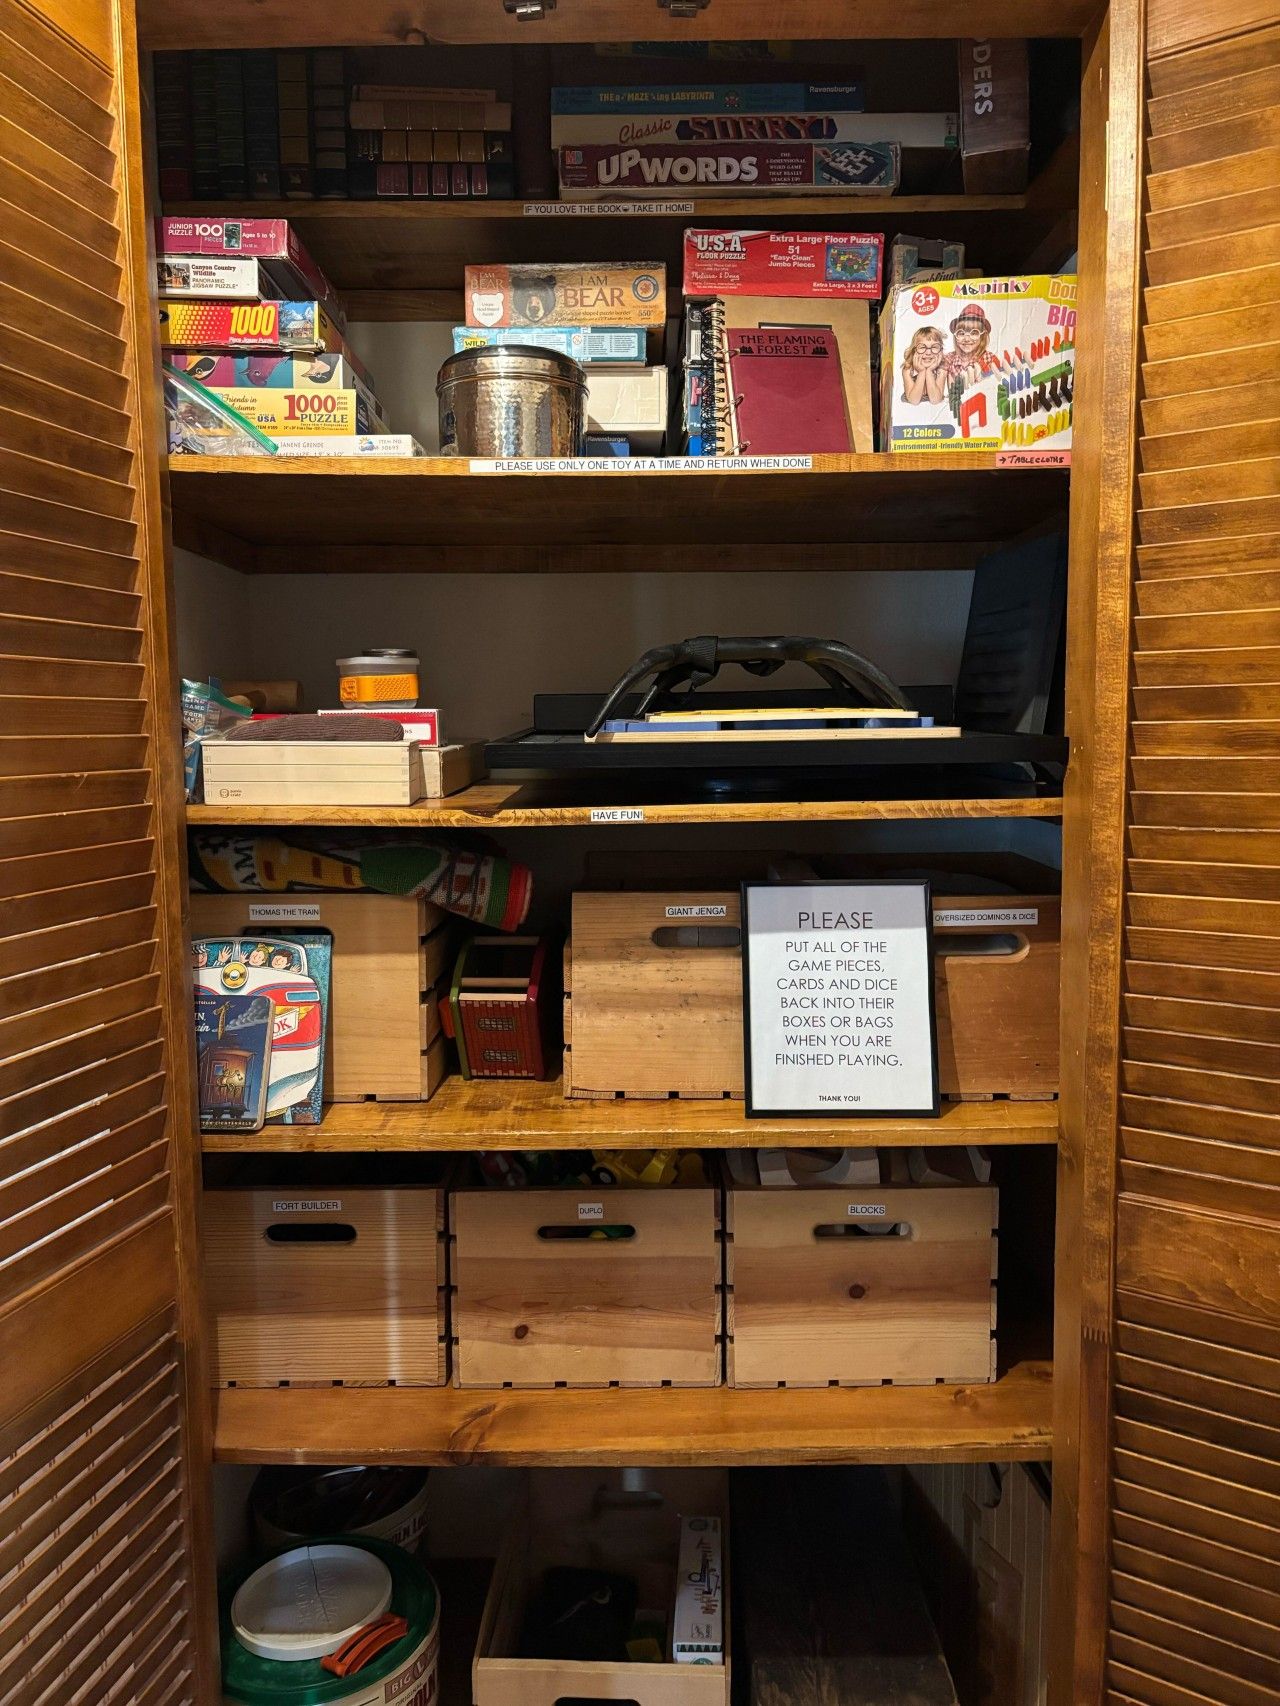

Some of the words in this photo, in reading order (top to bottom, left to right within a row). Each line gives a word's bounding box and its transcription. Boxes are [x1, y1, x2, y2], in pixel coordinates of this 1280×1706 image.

[973, 37, 993, 115] DERS
[809, 86, 857, 94] Ravensburger
[671, 91, 715, 101] LABYRINTH
[618, 118, 672, 144] Classic
[524, 205, 532, 214] IF
[534, 205, 552, 214] YOU
[554, 205, 577, 214] LOVE
[579, 205, 596, 213] THE
[597, 204, 622, 213] BOOK
[632, 204, 654, 213] TAKE
[655, 204, 663, 212] IT
[665, 203, 692, 212] HOME!
[194, 223, 223, 237] 100
[697, 234, 747, 252] U.S.A.
[769, 234, 794, 243] Extra
[796, 235, 822, 245] Large
[824, 235, 848, 244] Floor
[850, 236, 880, 245] Puzzle
[788, 245, 800, 254] 51
[696, 252, 719, 260] FLOOR
[719, 252, 746, 260] PUZZLE
[191, 264, 213, 272] Canyon
[213, 264, 236, 272] Country
[471, 278, 504, 289] BEAR
[587, 275, 608, 286] AM
[952, 279, 1032, 297] Mopinky
[563, 287, 626, 308] BEAR
[914, 291, 937, 306] 3+
[918, 304, 935, 313] AGES
[230, 305, 276, 336] 1000
[1046, 304, 1077, 327] Blo
[738, 335, 765, 344] THE
[768, 335, 826, 345] FLAMING
[755, 345, 808, 355] FOREST
[250, 395, 258, 403] in
[284, 394, 336, 421] 1000
[257, 415, 277, 423] USA
[300, 413, 349, 423] PUZZLE
[902, 428, 913, 438] 12
[913, 427, 942, 438] Colors
[893, 442, 938, 451] Environmental
[964, 441, 983, 450] Water
[495, 461, 533, 471] PLEASE
[536, 461, 555, 471] USE
[558, 461, 585, 471] ONLY
[588, 460, 609, 470] ONE
[610, 460, 632, 470] TOY
[634, 460, 647, 470] AT
[649, 460, 656, 470] A
[658, 460, 681, 470] TIME
[683, 459, 704, 469] AND
[707, 459, 748, 469] RETURN
[751, 459, 780, 468] WHEN
[783, 458, 811, 468] DONE
[1007, 455, 1064, 464] TABLECLOTHS
[592, 811, 618, 820] HAVE
[620, 810, 643, 819] FUN!
[251, 908, 281, 916] THOMAS
[282, 908, 297, 916] THE
[298, 908, 319, 916] TRAIN
[667, 907, 693, 916] GIANT
[695, 907, 726, 915] JENGA
[798, 911, 874, 929] PLEASE
[935, 914, 976, 922] OVERSIZED
[976, 913, 1011, 921] DOMINOS
[785, 941, 809, 953] PUT
[813, 941, 837, 953] ALL
[840, 941, 860, 953] OF
[863, 941, 887, 953] THE
[788, 960, 832, 972] GAME
[836, 960, 885, 973] PIECES,
[776, 978, 825, 991] CARDS
[829, 978, 861, 991] AND
[865, 978, 898, 991] DICE
[780, 997, 819, 1009] BACK
[823, 997, 855, 1009] INTO
[859, 997, 894, 1010] THEIR
[272, 1018, 292, 1034] OK
[782, 1015, 826, 1028] BOXES
[830, 1015, 851, 1028] OR
[855, 1016, 894, 1028] BAGS
[785, 1034, 827, 1047] WHEN
[830, 1034, 861, 1047] YOU
[865, 1035, 892, 1047] ARE
[775, 1053, 835, 1066] FINISHED
[838, 1054, 903, 1067] PLAYING.
[275, 1202, 300, 1211] FORT
[301, 1201, 339, 1210] BUILDER
[849, 1205, 885, 1214] BLOCKS
[391, 1673, 411, 1694] BIG
